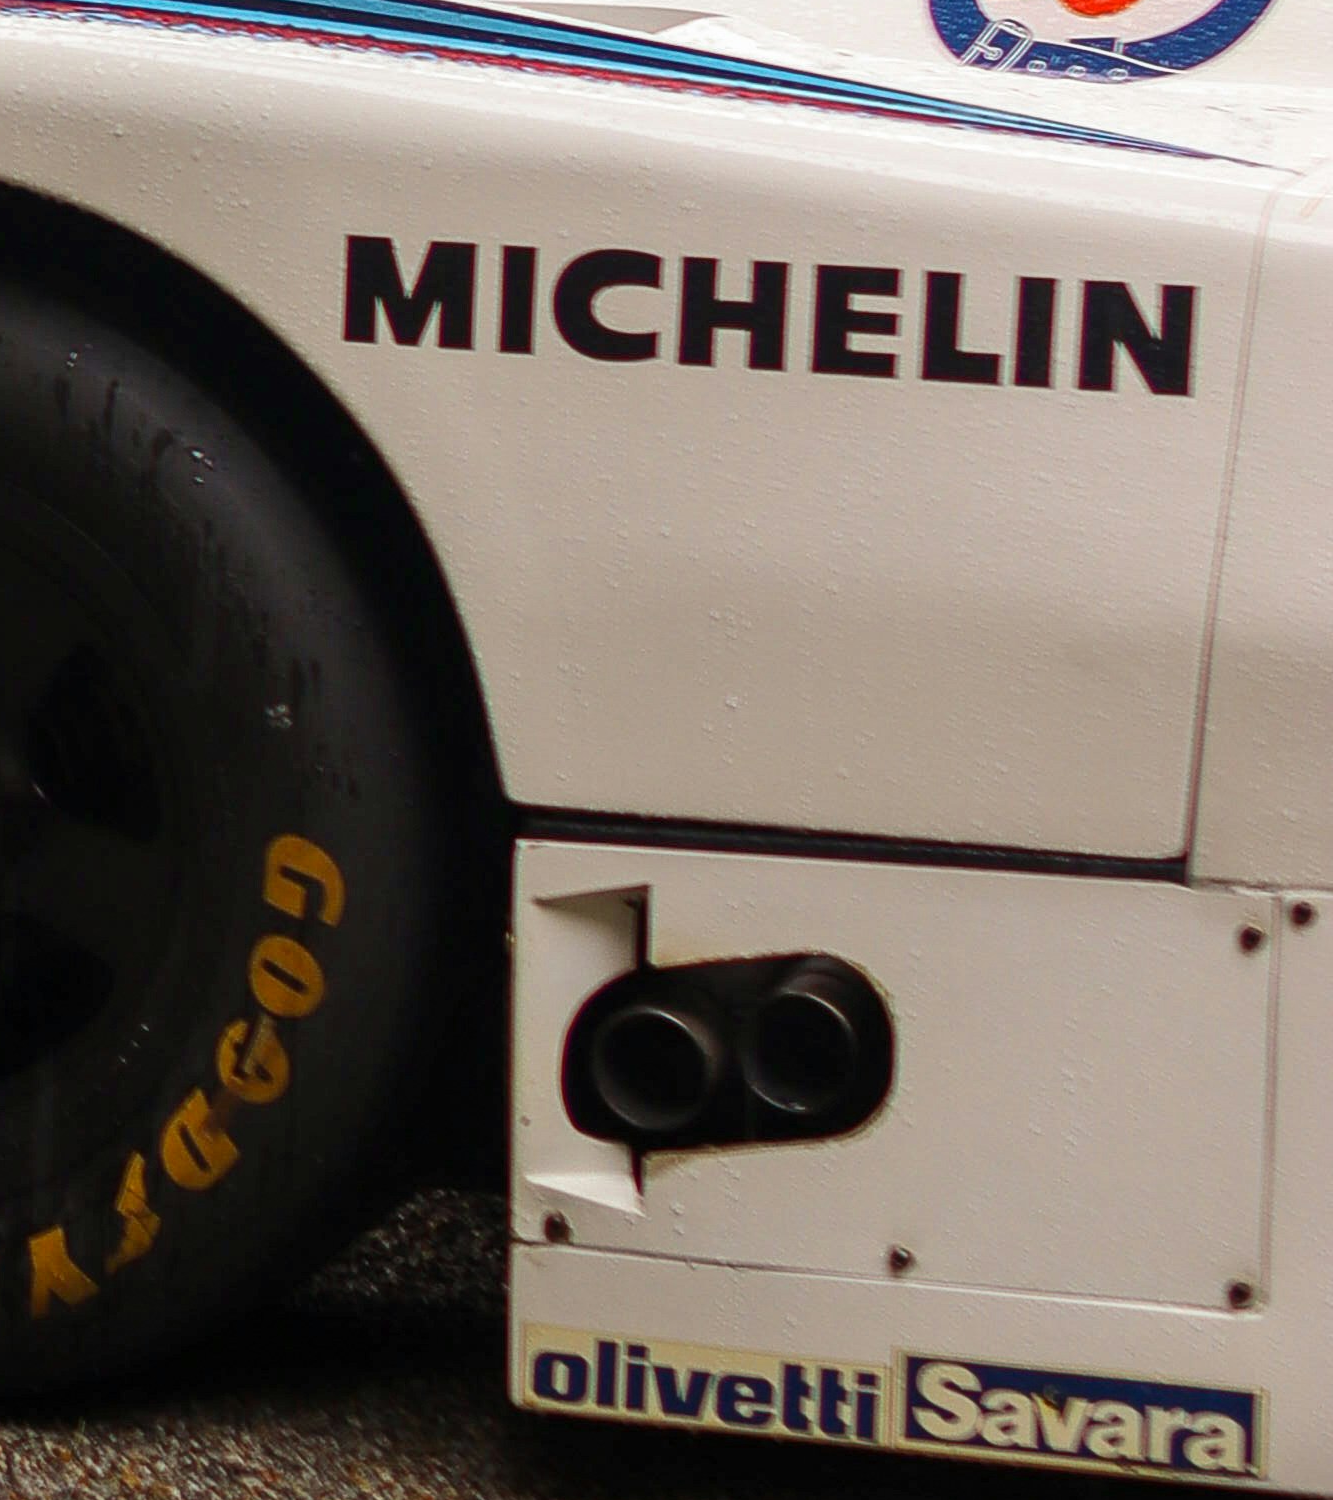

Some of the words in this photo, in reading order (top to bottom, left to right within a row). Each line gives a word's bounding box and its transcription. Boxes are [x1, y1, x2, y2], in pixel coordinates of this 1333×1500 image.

[343, 234, 1200, 398] MICHELIN
[532, 1341, 881, 1444] olivetti
[912, 1362, 1252, 1474] Savara
